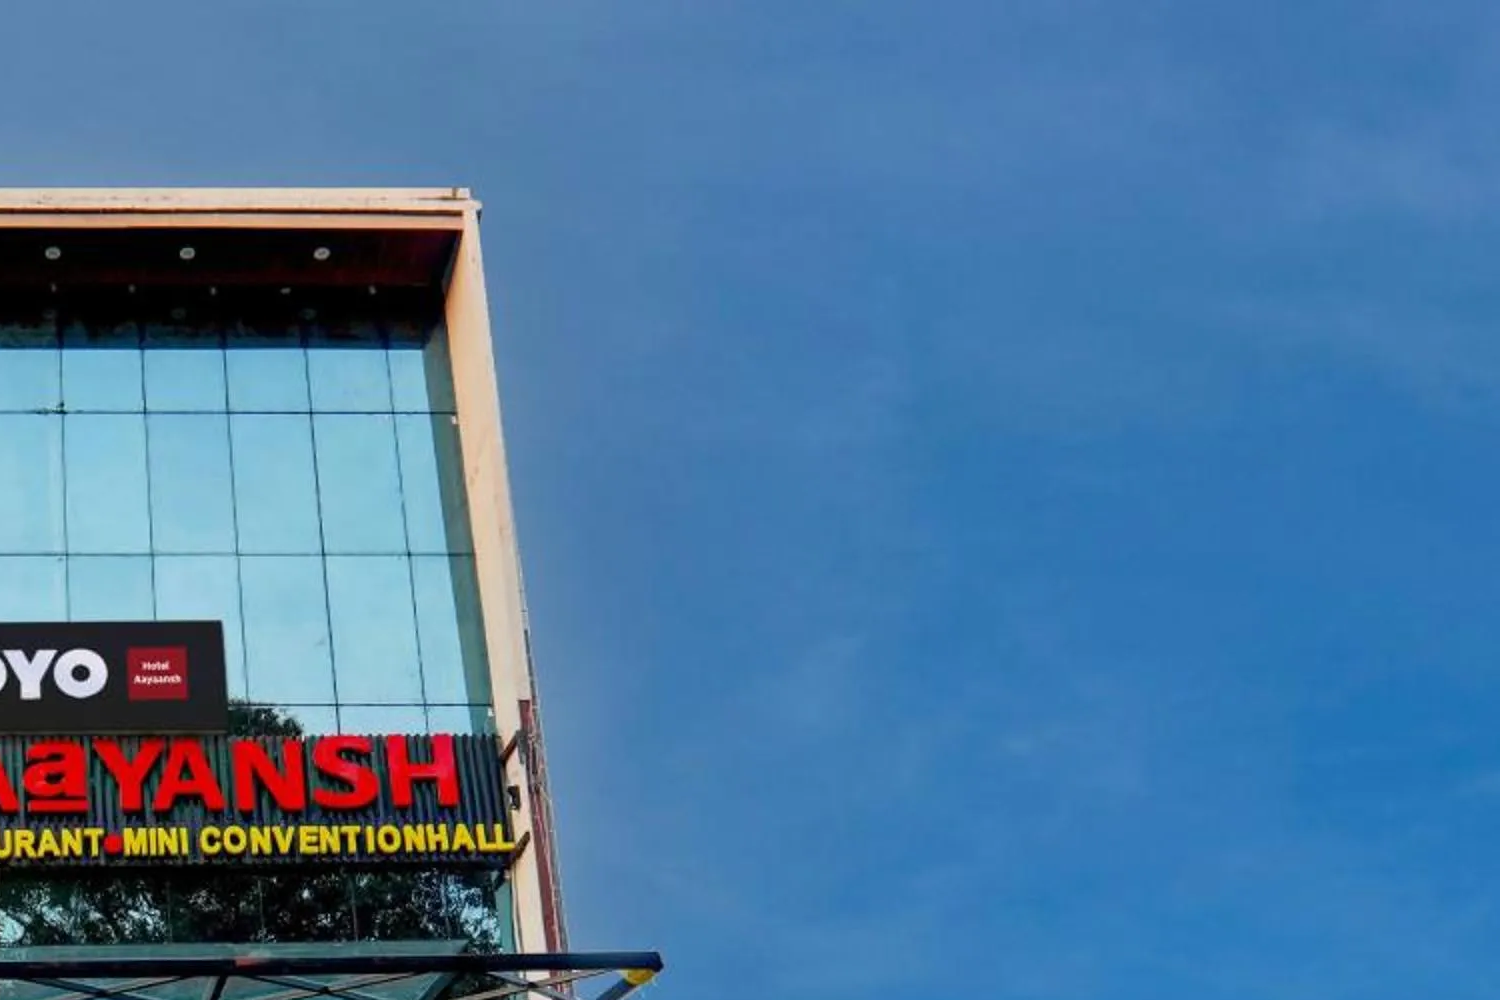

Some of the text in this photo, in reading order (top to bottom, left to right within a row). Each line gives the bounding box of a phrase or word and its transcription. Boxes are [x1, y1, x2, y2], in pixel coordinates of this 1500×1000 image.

[141, 661, 170, 670] Hotel
[122, 826, 189, 858] MINI
[200, 822, 515, 855] CONVENTIONHALL
